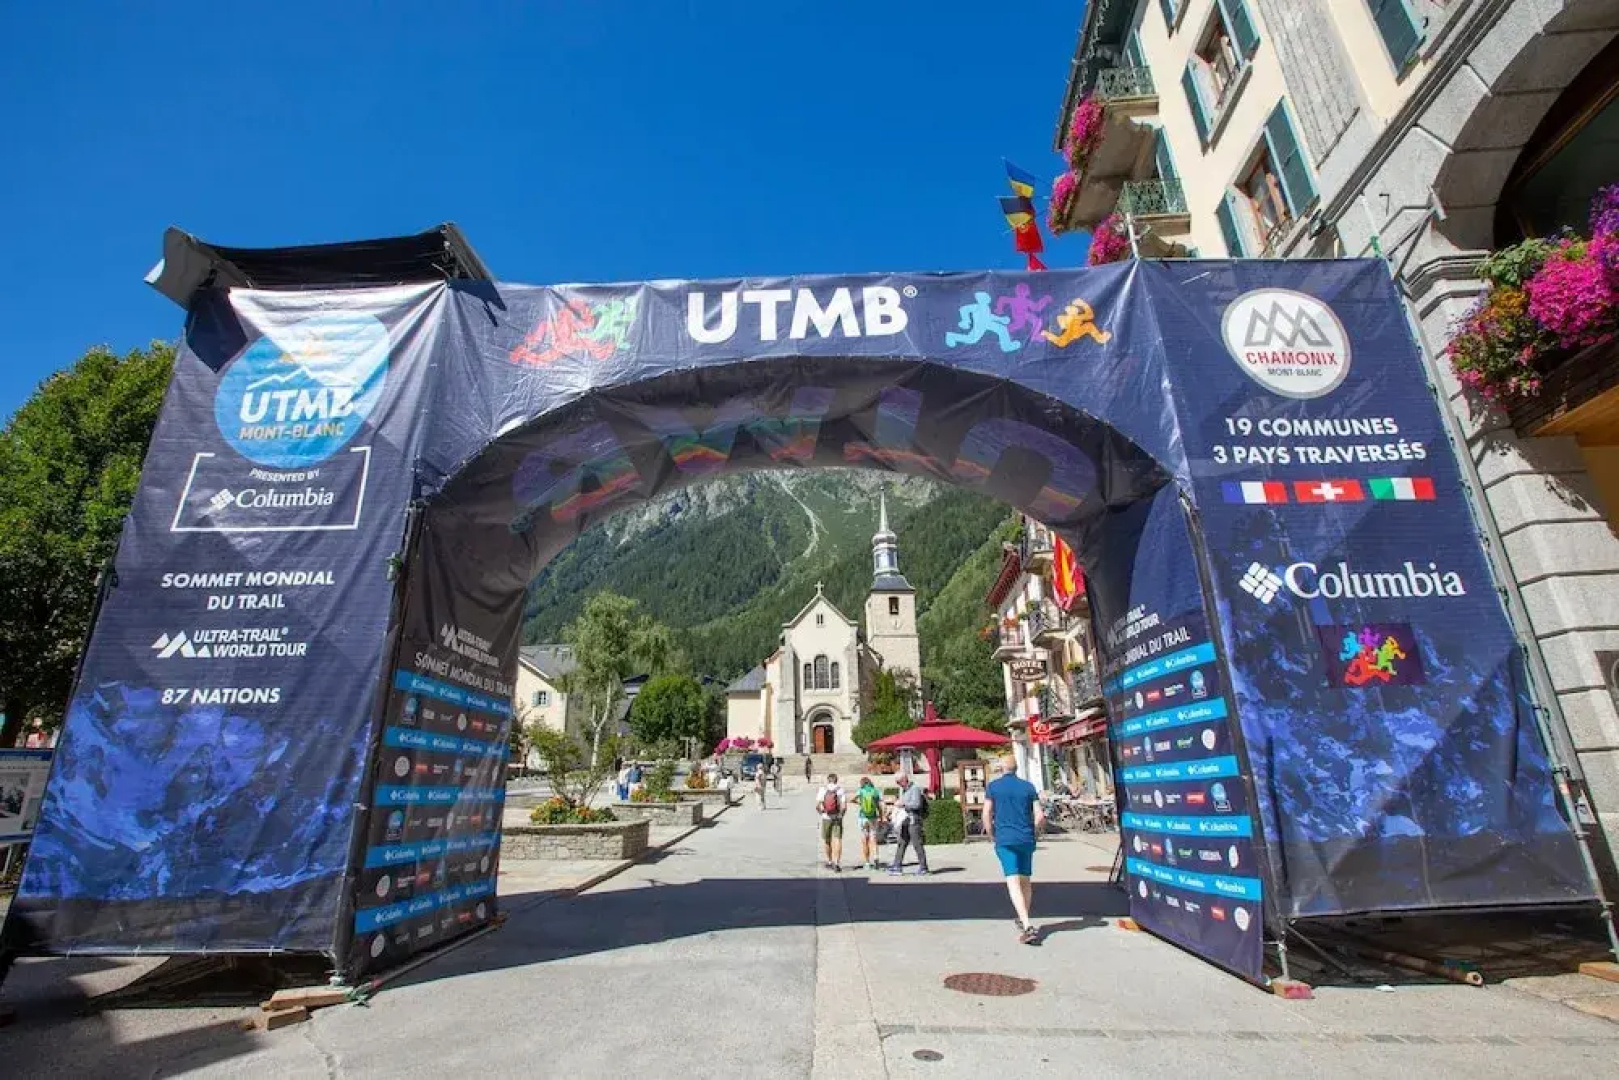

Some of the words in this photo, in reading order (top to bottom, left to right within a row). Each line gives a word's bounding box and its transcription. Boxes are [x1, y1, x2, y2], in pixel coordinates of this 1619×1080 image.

[1245, 350, 1337, 365] CHAMONIX
[240, 387, 356, 423] UTMB
[240, 422, 345, 440] MONT-BLANC
[1225, 417, 1252, 435] 19
[1258, 417, 1399, 437] COMMUNES
[1213, 445, 1228, 464] 3
[1233, 446, 1290, 464] PAYS
[1294, 438, 1426, 464] TRAVERSÉS
[249, 467, 305, 482] PRESENTED
[307, 468, 320, 480] BY
[235, 487, 335, 508] Columbia
[160, 572, 244, 588] SOMMET
[245, 571, 335, 587] MONDIAL
[1284, 561, 1466, 599] Columbia
[207, 595, 234, 610] DU
[238, 594, 286, 610] TRAIL
[1163, 626, 1191, 648] TRAIL
[212, 643, 267, 658] WORLD
[269, 642, 308, 657] TOUR
[161, 688, 189, 704] 87
[190, 687, 281, 704] NATIONS
